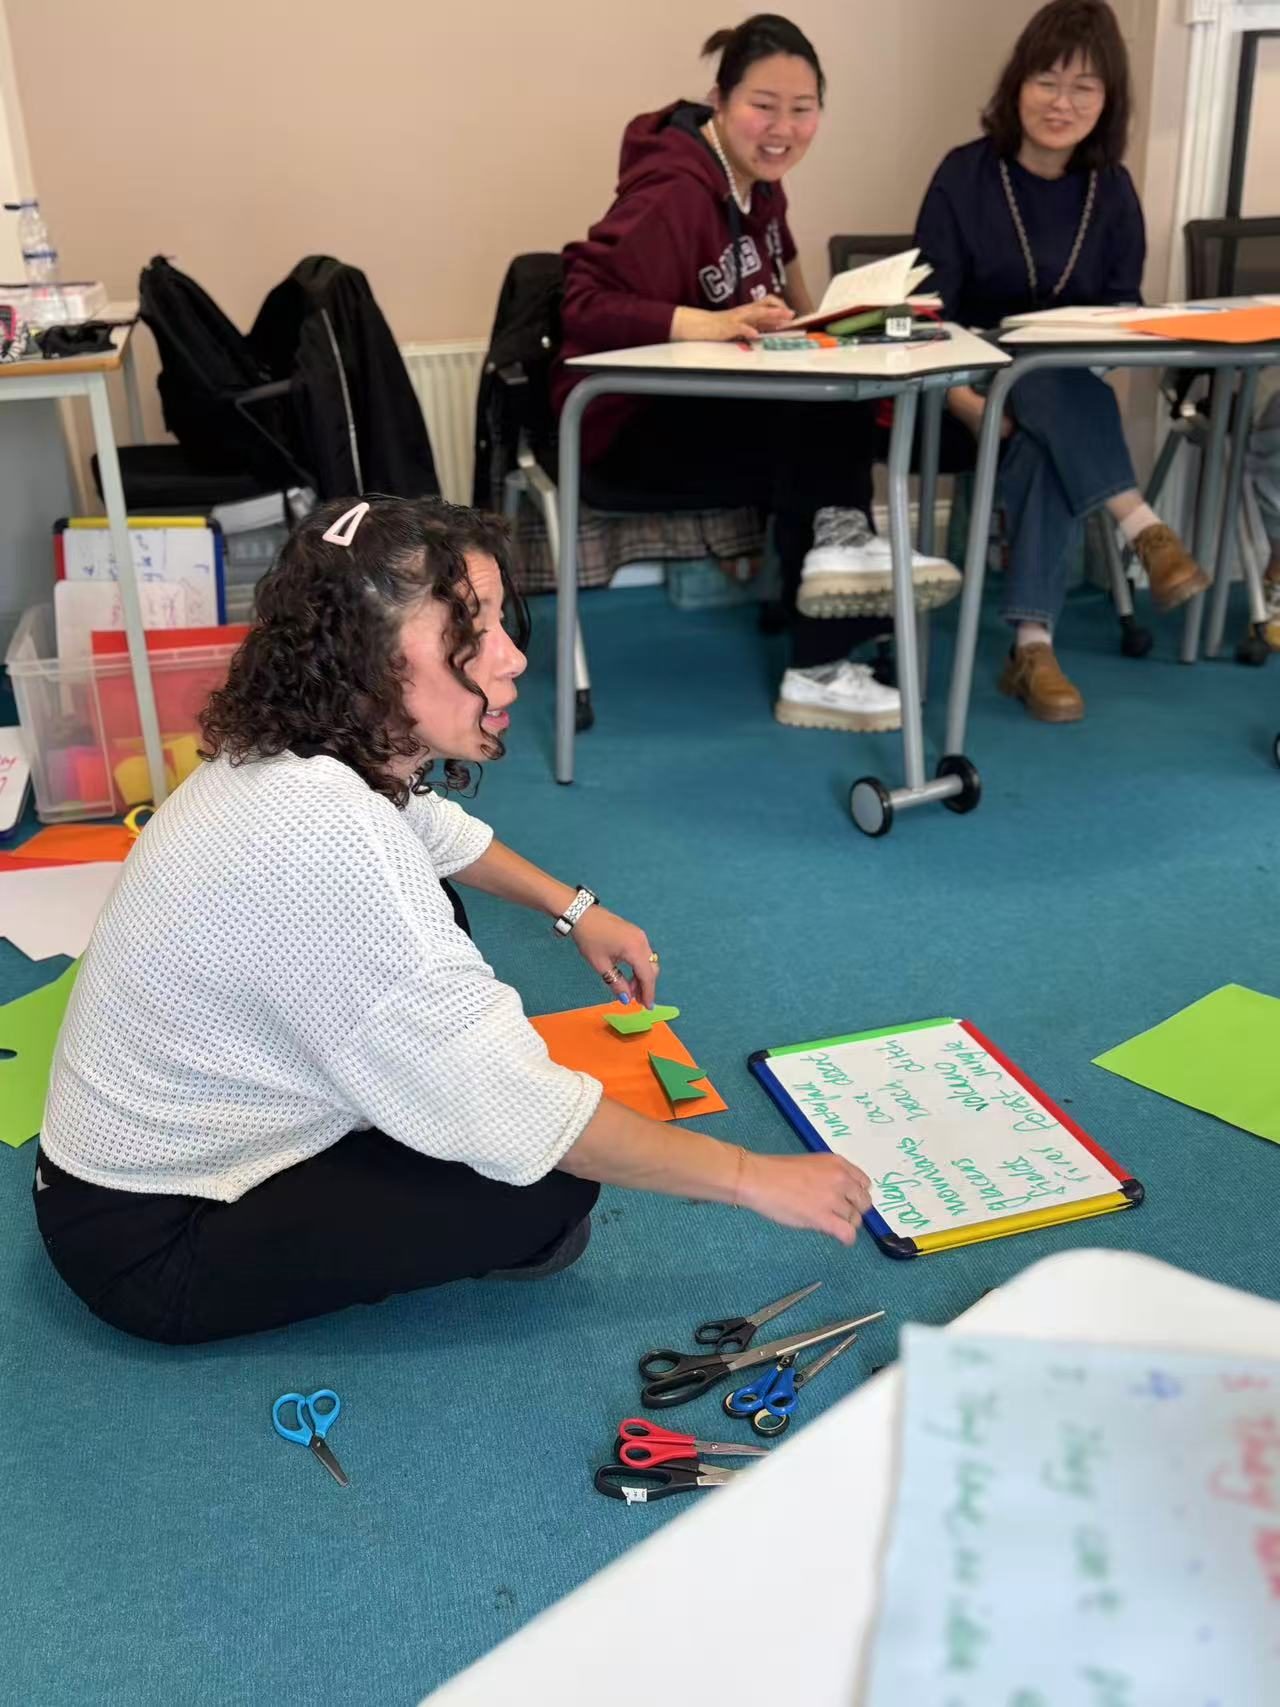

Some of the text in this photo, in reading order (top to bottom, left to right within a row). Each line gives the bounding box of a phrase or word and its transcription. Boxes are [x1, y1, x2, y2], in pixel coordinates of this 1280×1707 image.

[874, 1040, 927, 1073] ditch
[943, 1040, 1002, 1081] jungle
[884, 1081, 932, 1121] beach
[934, 1061, 990, 1112] volcano
[793, 1082, 853, 1138] waterfall
[990, 1089, 1060, 1132] forest
[896, 1136, 968, 1217] mountains
[998, 1155, 1068, 1204] fields
[1029, 1146, 1093, 1182] river
[875, 1171, 933, 1230] valleys
